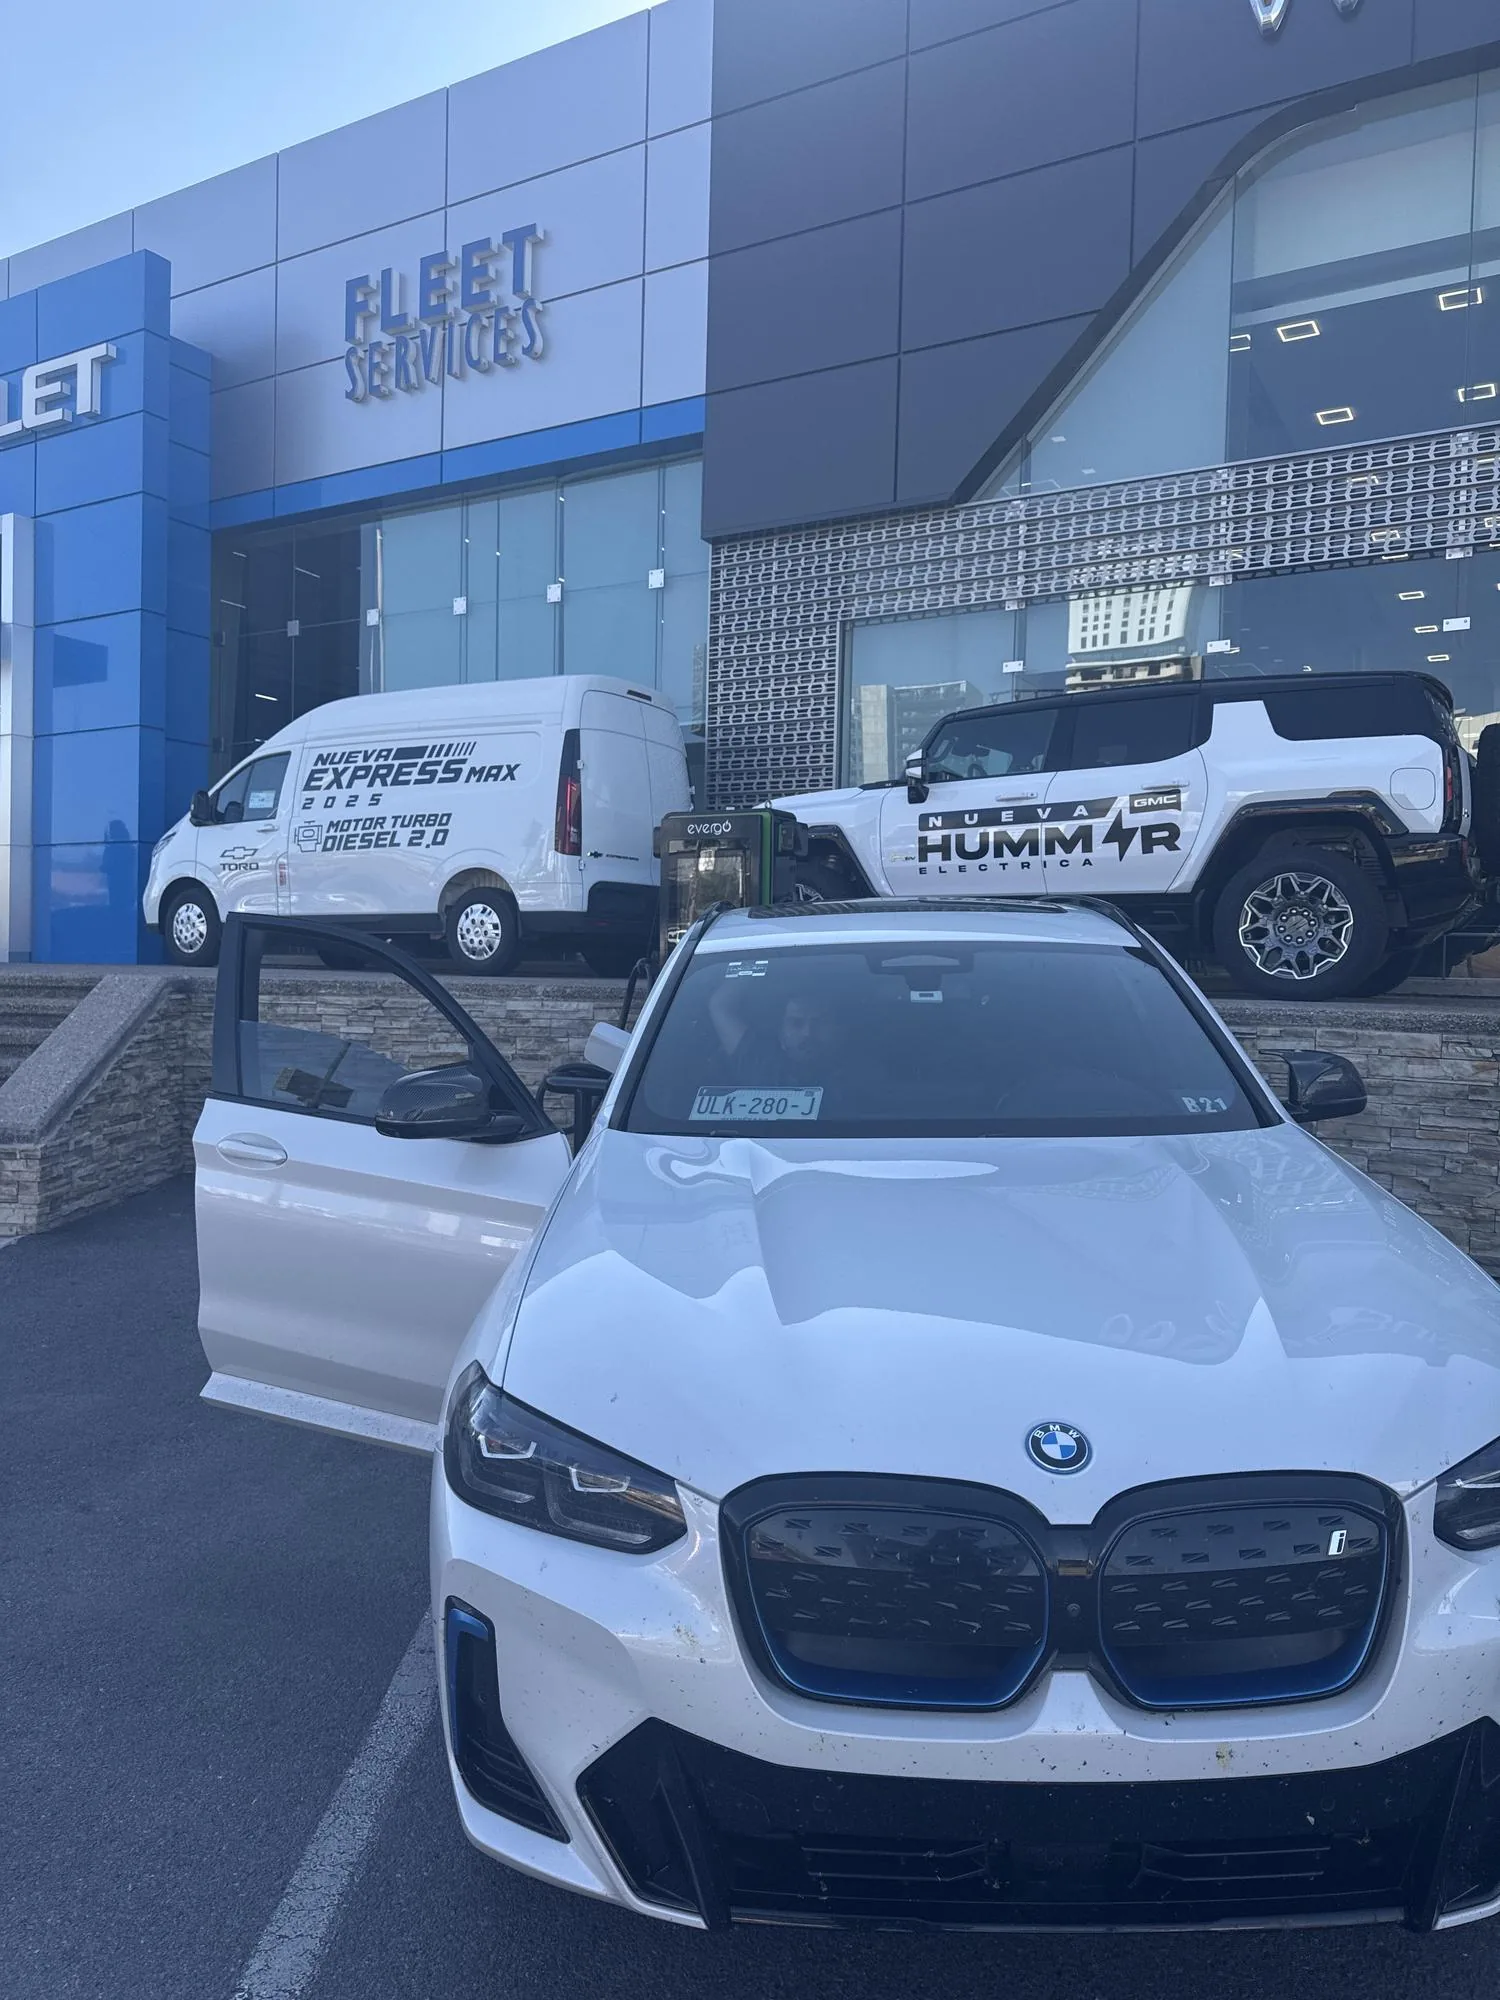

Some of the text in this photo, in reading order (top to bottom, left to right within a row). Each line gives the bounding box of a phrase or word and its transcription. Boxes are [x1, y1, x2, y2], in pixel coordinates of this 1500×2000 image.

[345, 223, 545, 345] FLEET
[345, 297, 544, 402] SERVICES
[313, 747, 390, 767] NUEVA
[302, 758, 521, 791] EXPRESS MAX
[301, 793, 383, 810] 2025
[1133, 794, 1177, 808] GMC
[326, 813, 452, 833] MOTOR TURBO
[928, 804, 1089, 828] NUEVA
[687, 820, 732, 836] evergo
[321, 828, 449, 852] DIESEL 2.0
[220, 862, 259, 872] TORO
[919, 858, 1093, 875] ELECTRICA
[697, 1097, 816, 1115] ULK-280-J
[1033, 1424, 1080, 1439] BMW
